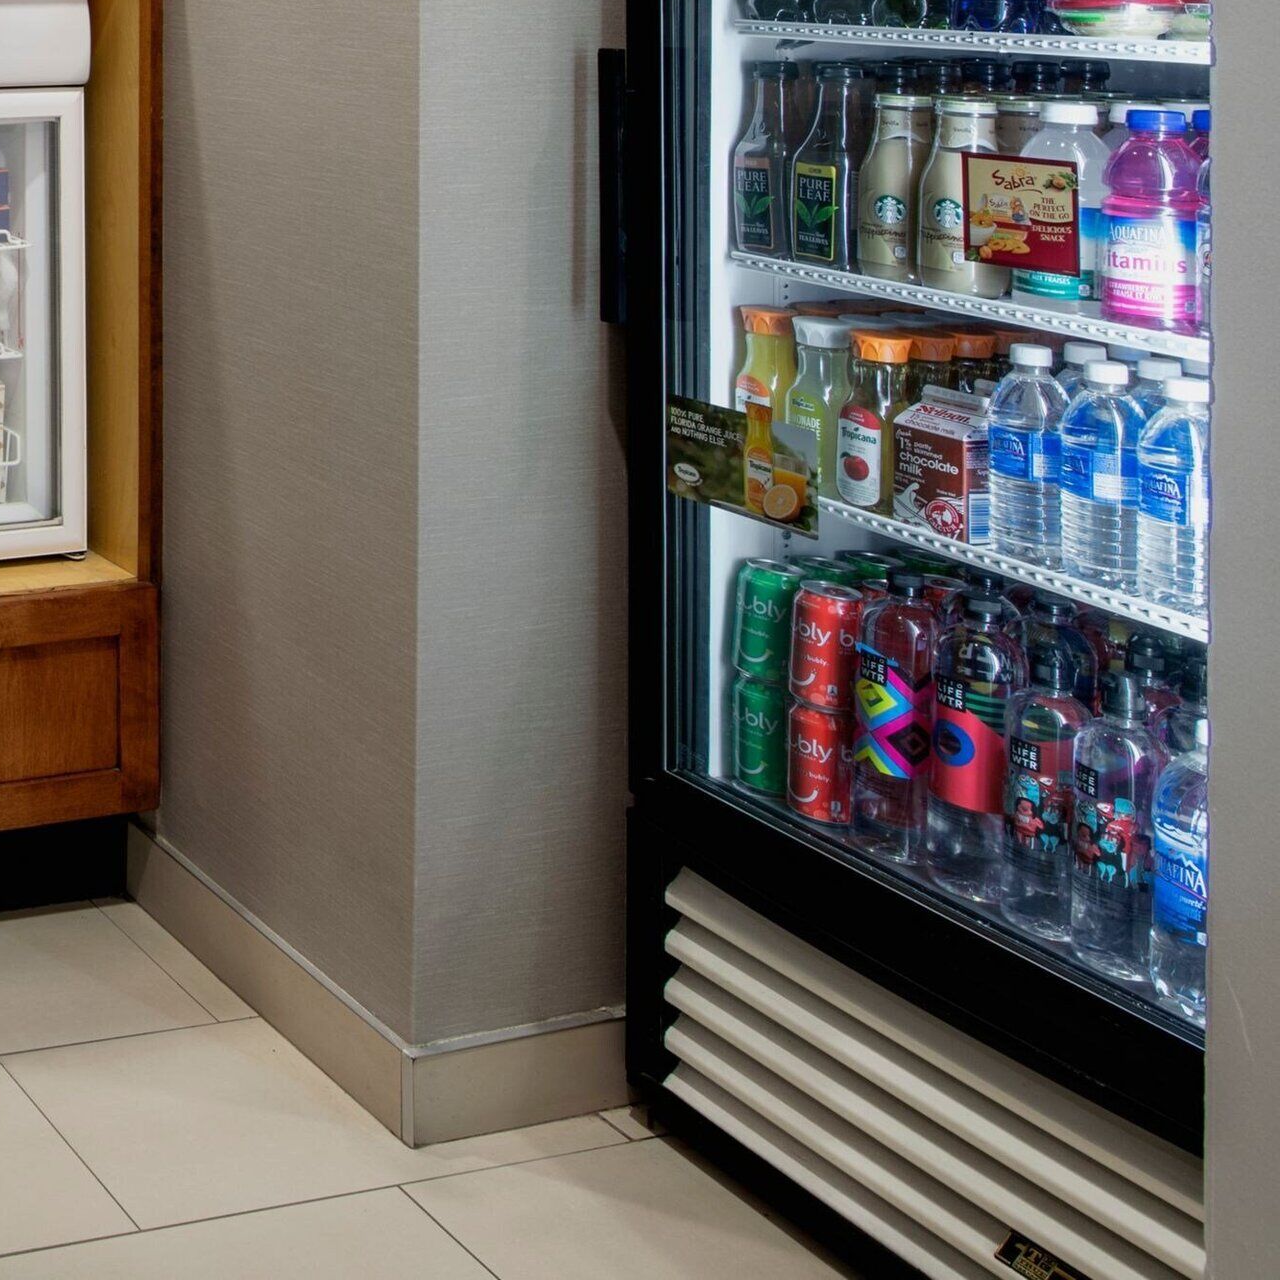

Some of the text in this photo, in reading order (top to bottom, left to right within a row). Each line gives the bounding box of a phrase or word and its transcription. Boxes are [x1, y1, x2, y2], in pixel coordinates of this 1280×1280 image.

[737, 170, 768, 182] PURE
[799, 176, 831, 191] PURE
[992, 169, 1035, 191] Sabra
[1029, 208, 1041, 216] ON
[1042, 211, 1056, 219] THE
[1033, 202, 1065, 213] PERFECT
[1032, 224, 1072, 234] DELICIOUS
[1040, 234, 1065, 242] SNACK
[687, 410, 705, 423] PURE
[670, 416, 696, 429] FLORIDA
[697, 422, 723, 438] ORANGE
[682, 427, 708, 442] NOTHING
[841, 426, 877, 445] Tropicana
[899, 450, 959, 476] chocolate
[899, 460, 923, 477] milk
[860, 656, 884, 673] LIFE
[860, 668, 886, 685] WTR
[1011, 744, 1037, 761] LIFE
[1011, 753, 1038, 770] WTR
